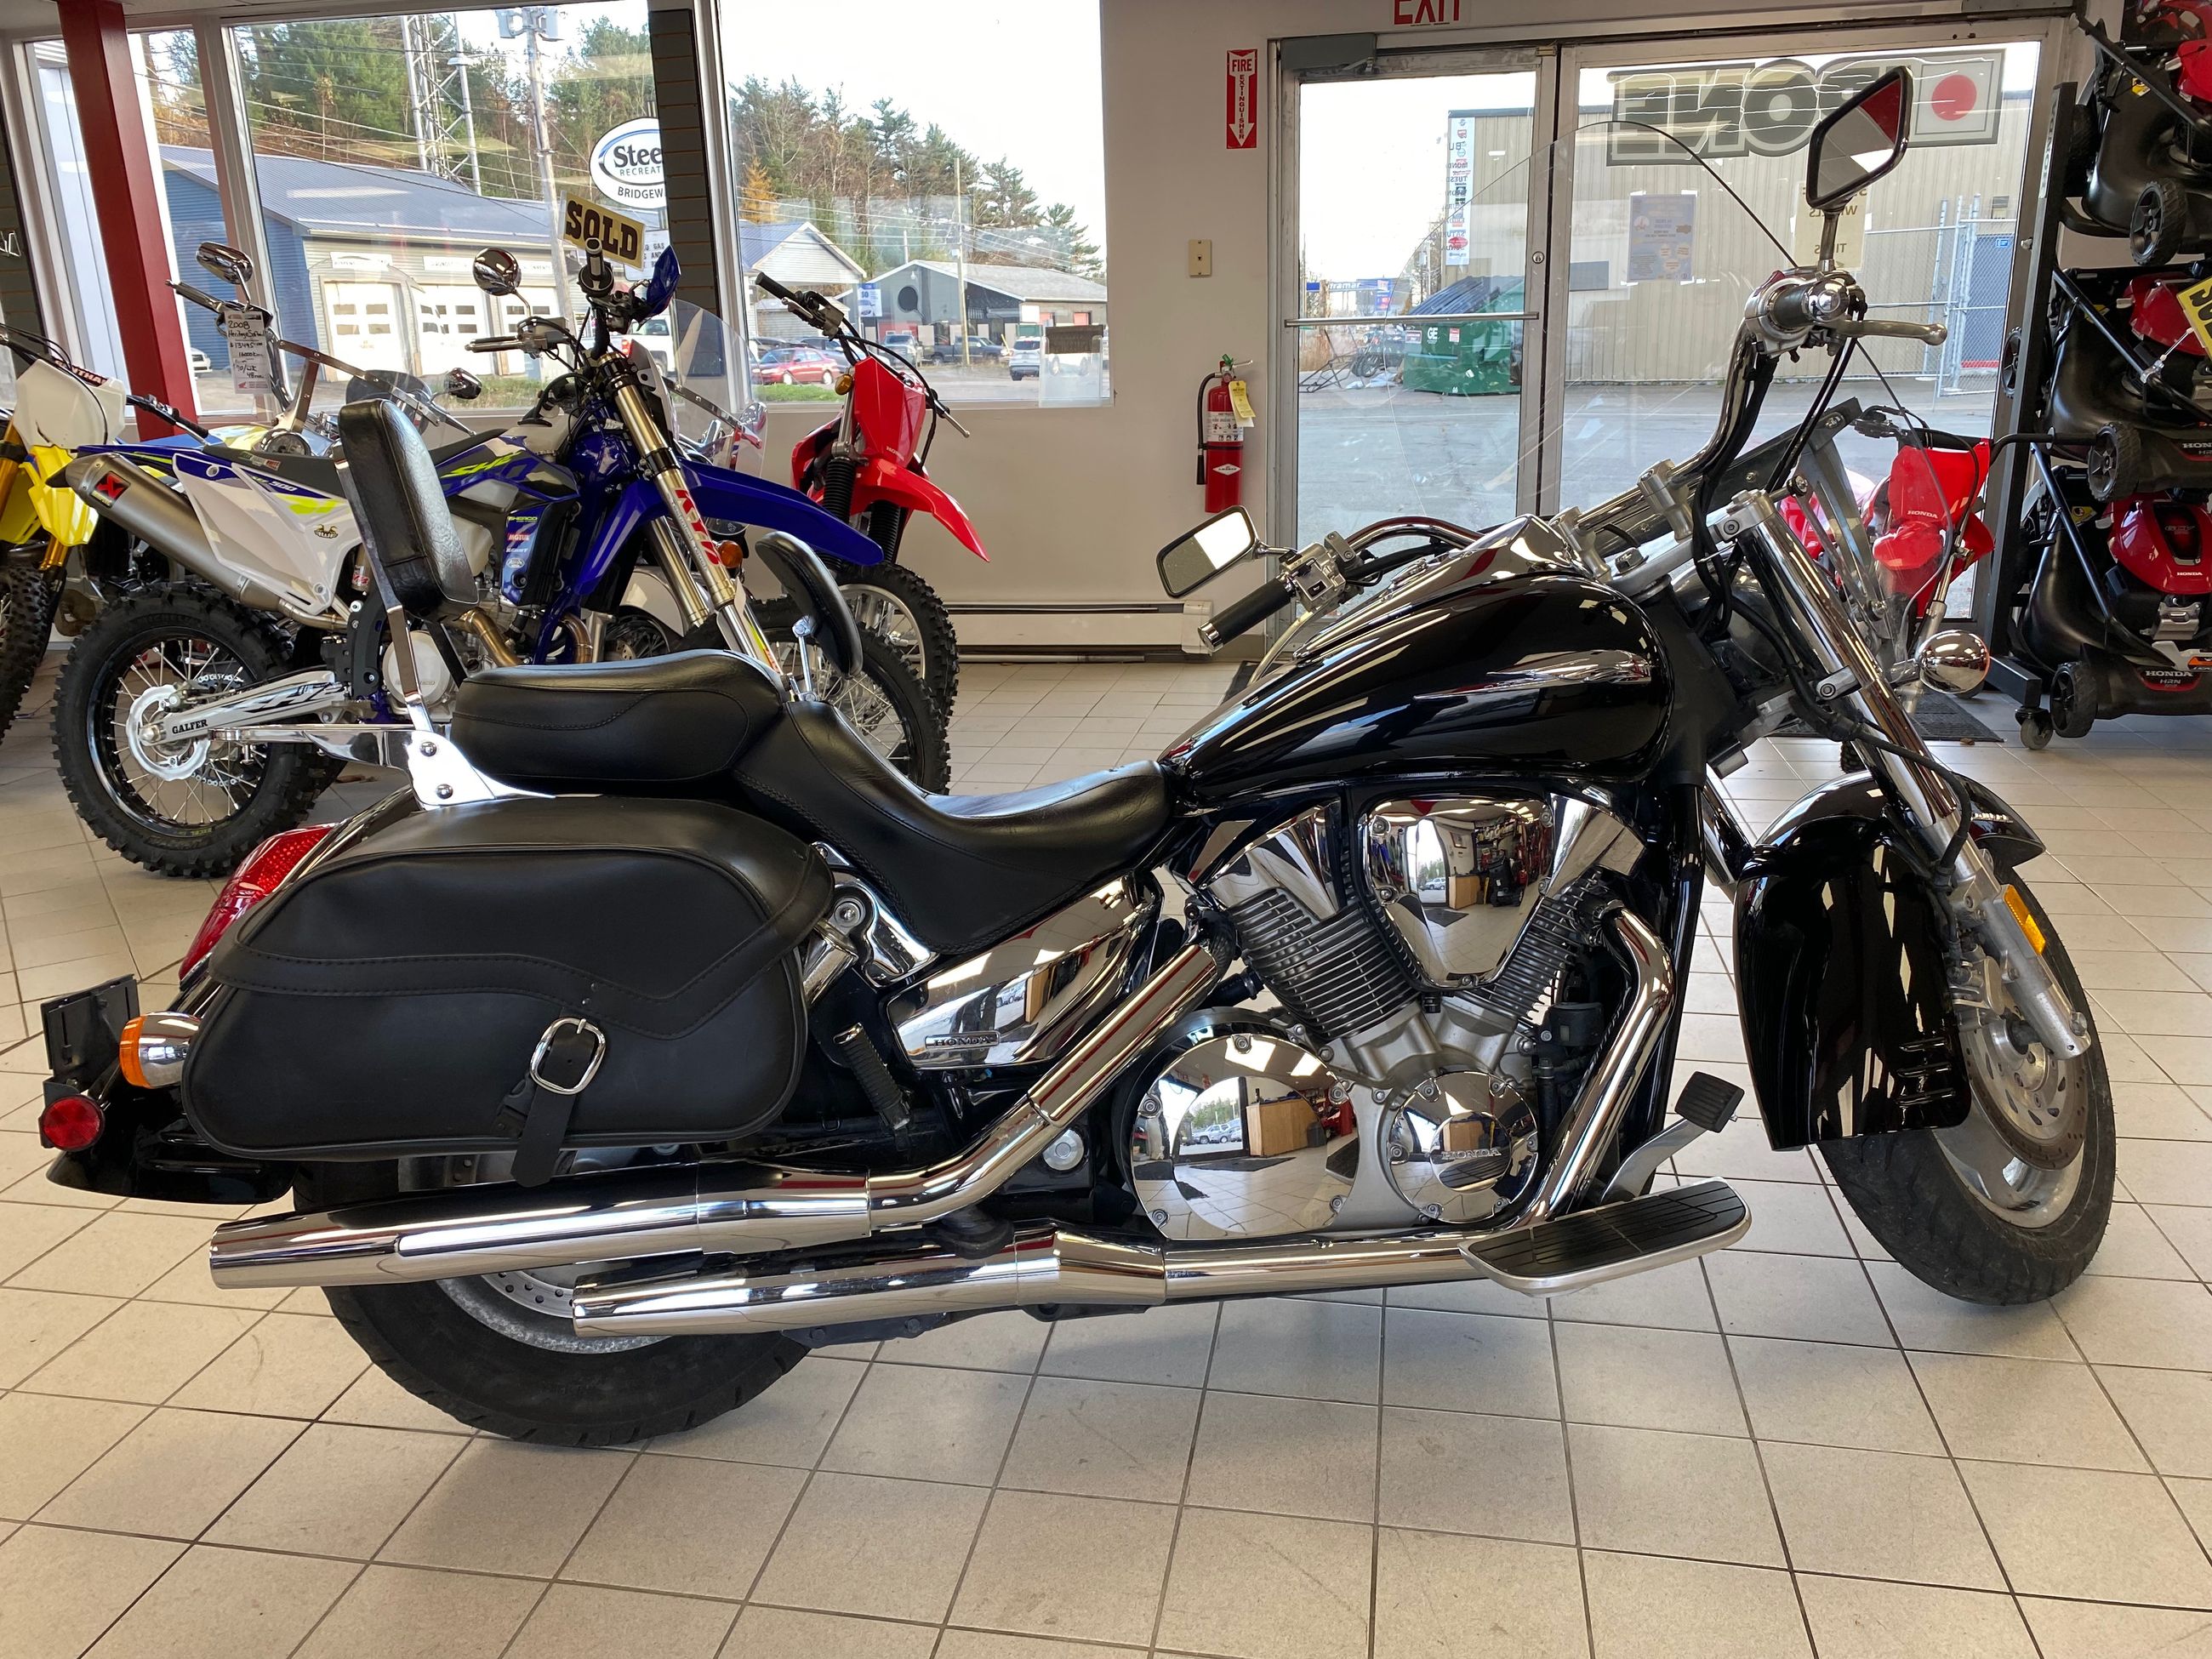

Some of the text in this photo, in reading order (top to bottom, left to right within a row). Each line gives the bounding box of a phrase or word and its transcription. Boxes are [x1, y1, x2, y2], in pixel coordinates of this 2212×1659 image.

[1232, 58, 1252, 72] FIRE
[619, 165, 661, 176] RECREAT
[618, 186, 666, 199] BRIDGEW
[565, 200, 638, 260] SOLD
[228, 321, 250, 330] 2008
[1427, 327, 1439, 340] GE
[1907, 510, 1938, 519] HONDA
[172, 719, 208, 735] GALFER
[932, 1036, 993, 1046] HONDA
[1440, 1148, 1502, 1160] HONDA
